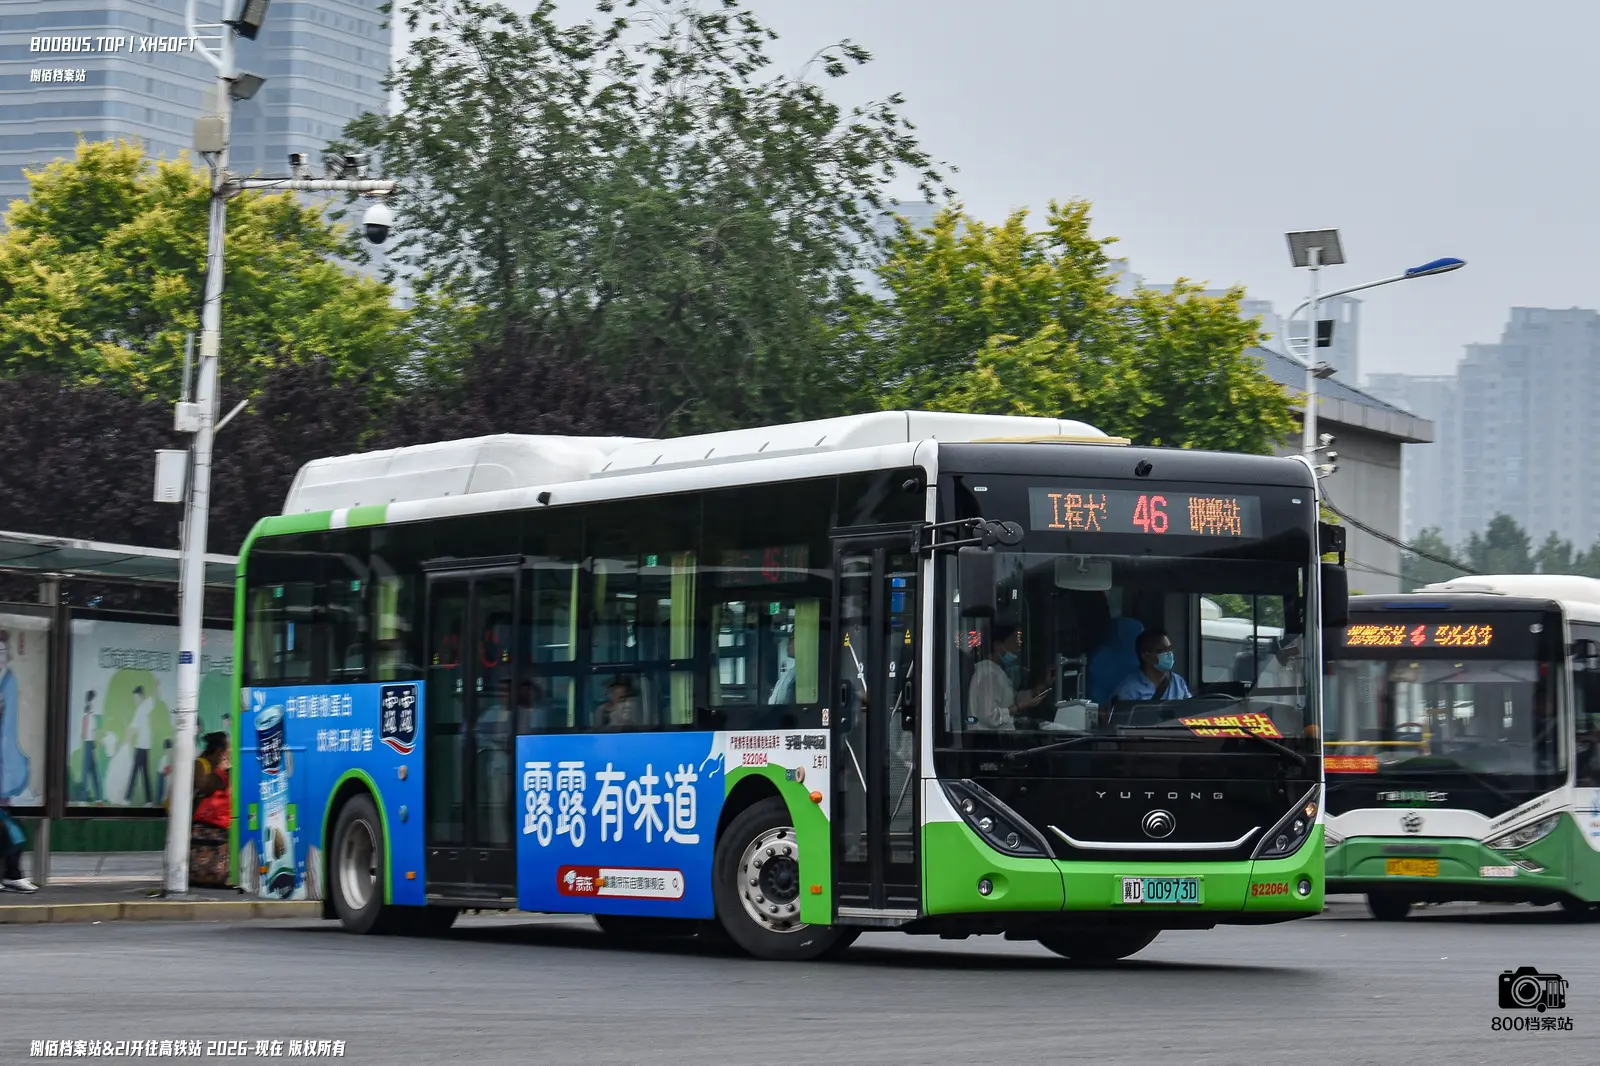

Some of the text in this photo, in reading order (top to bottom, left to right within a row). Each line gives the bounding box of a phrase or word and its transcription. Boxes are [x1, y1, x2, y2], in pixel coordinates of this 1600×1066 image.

[1133, 495, 1169, 533] 46
[1188, 496, 1242, 535] 邯郸站
[742, 752, 768, 765] 522064
[1096, 790, 1224, 800] YUTONG
[523, 761, 700, 847] 露露有味道
[1252, 882, 1289, 897] 522064
